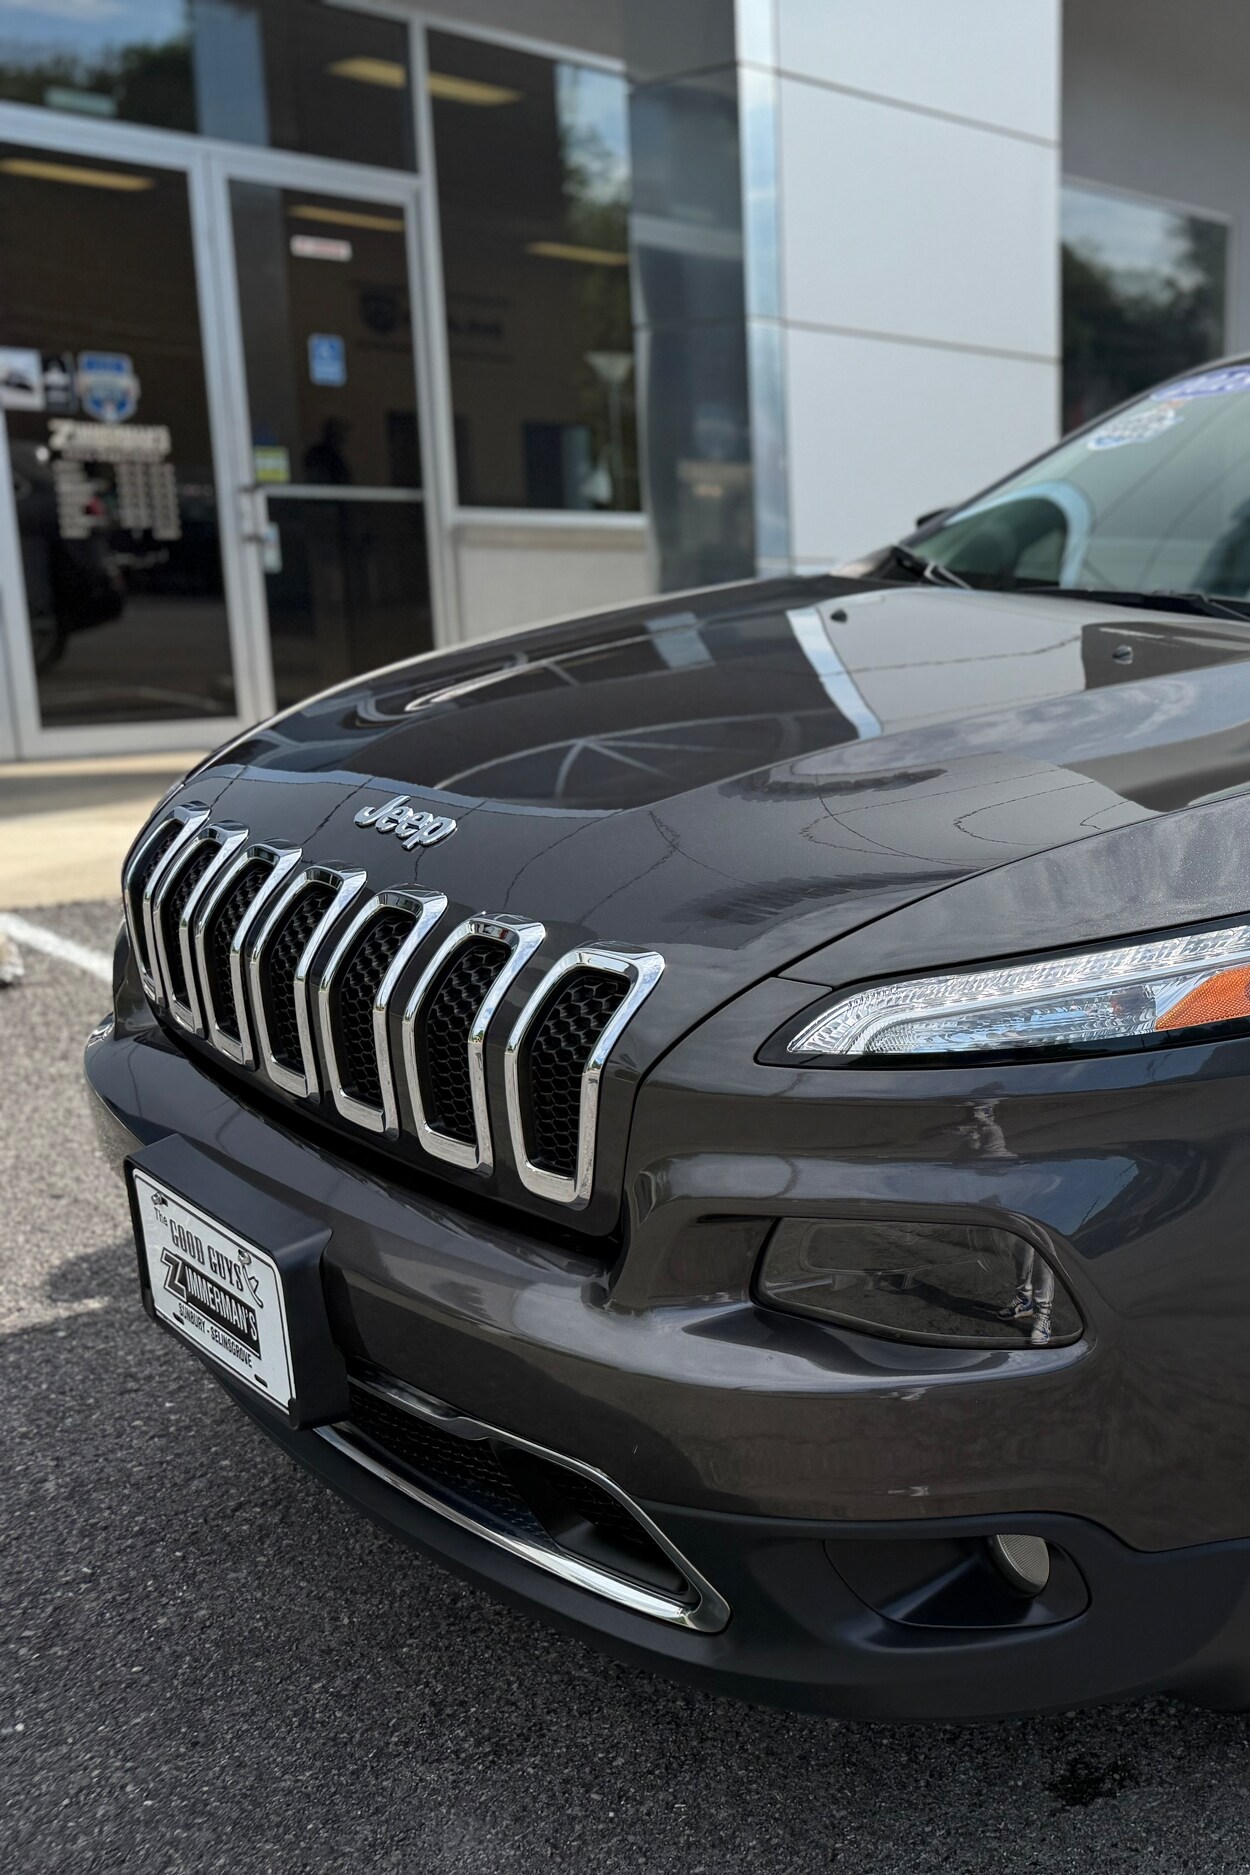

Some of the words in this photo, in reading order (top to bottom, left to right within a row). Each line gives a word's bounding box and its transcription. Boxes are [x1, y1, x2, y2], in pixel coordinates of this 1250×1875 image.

[354, 795, 458, 850] Jeep
[154, 1207, 168, 1226] The
[170, 1219, 205, 1266] GOOD
[208, 1245, 244, 1292] GUYS
[160, 1247, 258, 1341] ZIMMERMAN'S
[178, 1302, 206, 1335] SUNBURY
[210, 1326, 253, 1369] SELINSGROVE
